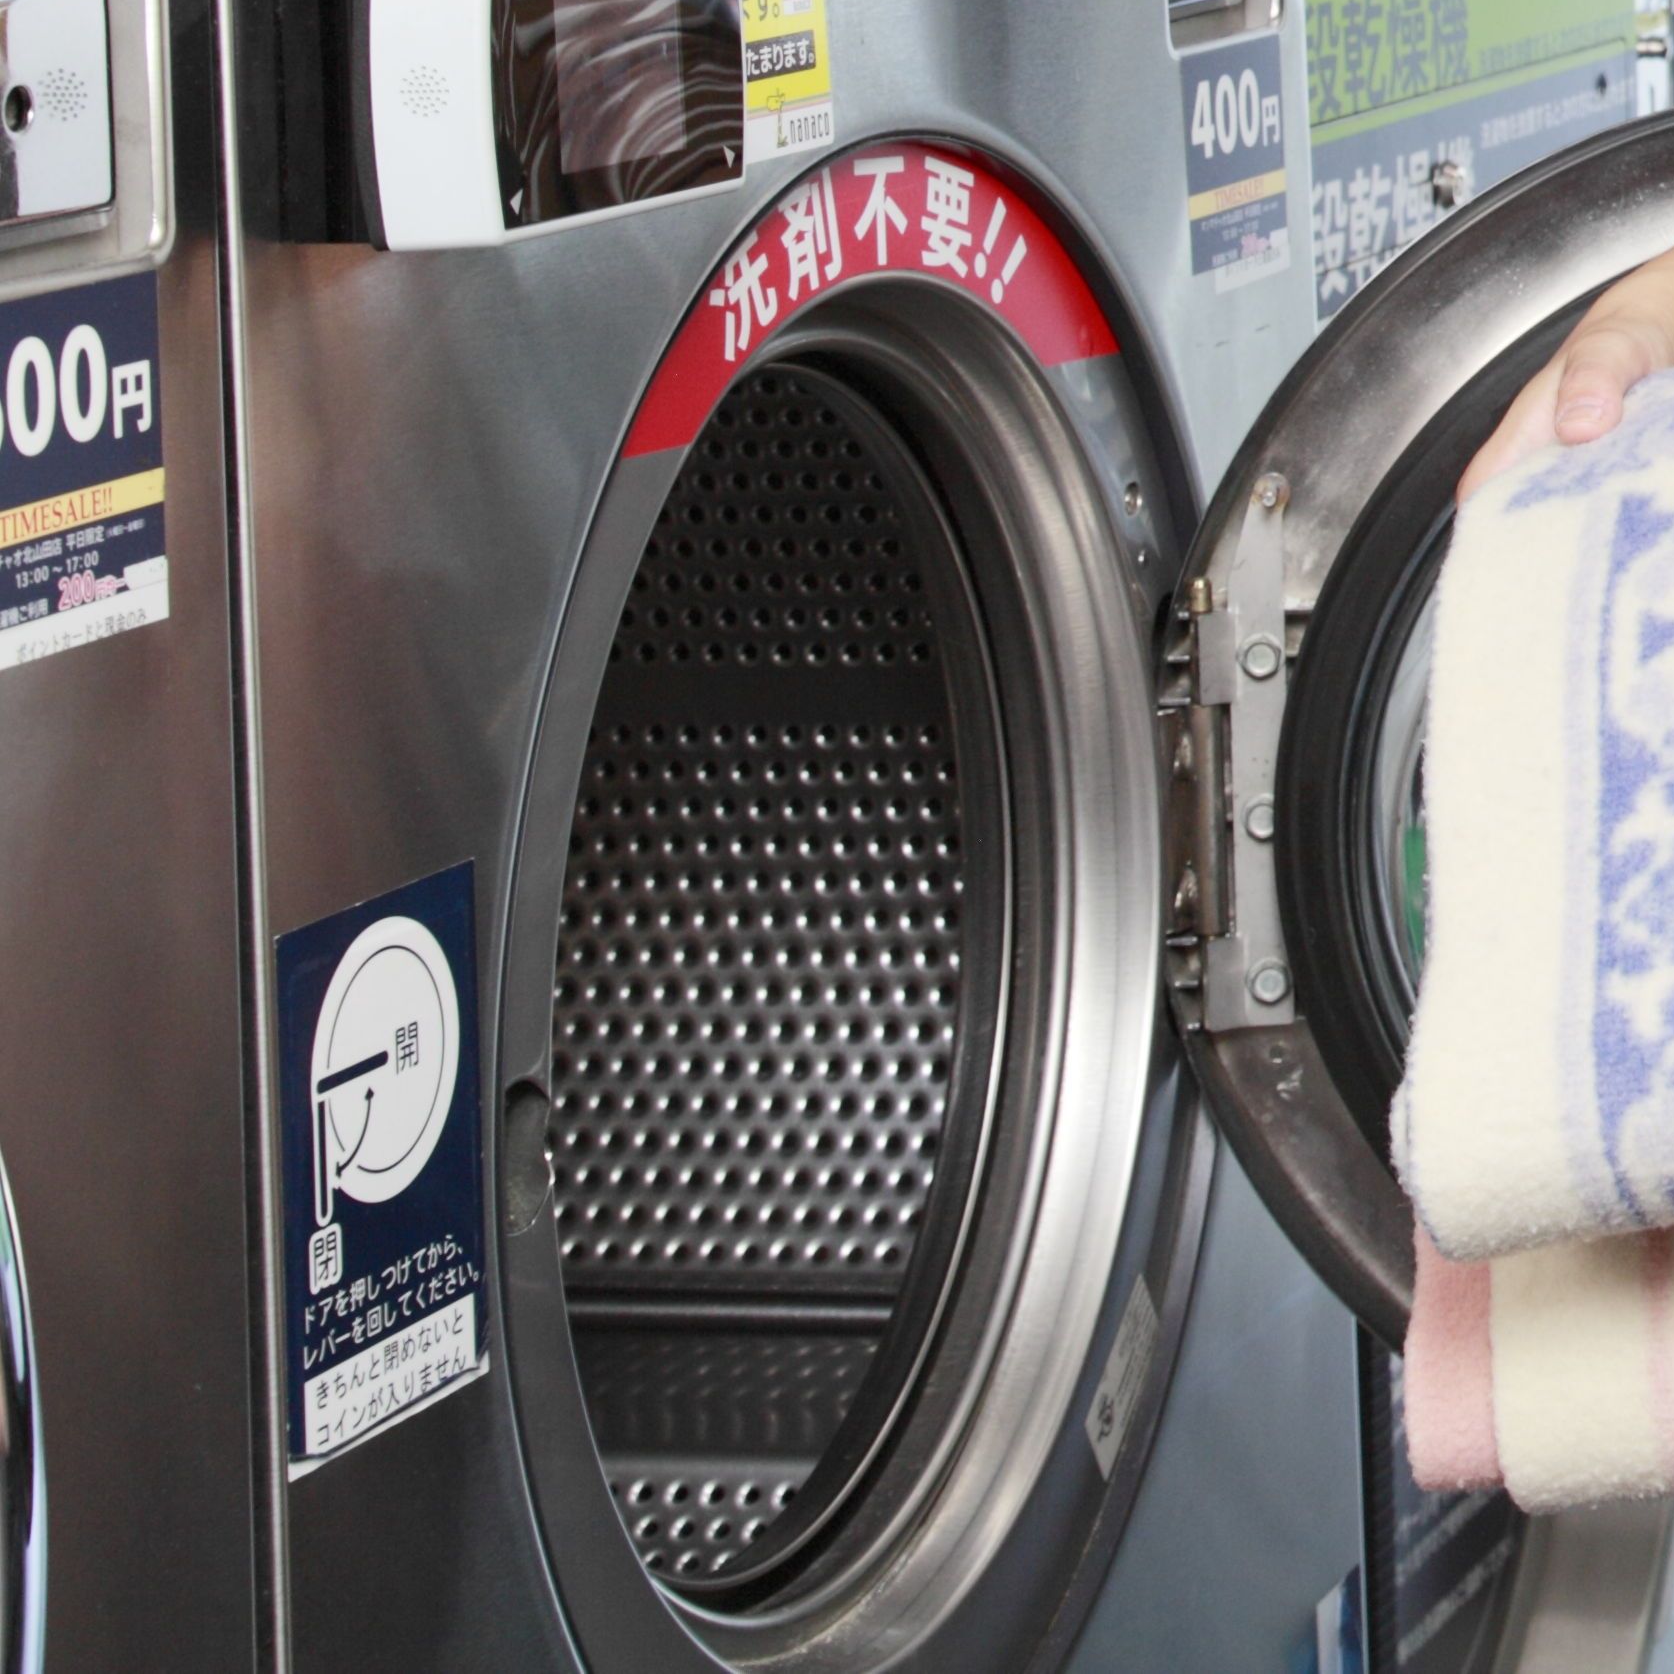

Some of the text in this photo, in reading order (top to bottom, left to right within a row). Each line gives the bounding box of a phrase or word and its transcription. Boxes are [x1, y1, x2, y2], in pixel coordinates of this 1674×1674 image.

[789, 111, 830, 144] nanaco
[1190, 67, 1281, 160] 400円
[0, 324, 153, 458] 00円
[15, 565, 50, 590] 13:00
[66, 549, 100, 574] 17:00
[395, 1020, 420, 1075] 開
[303, 1234, 465, 1335] ドアを押しつけてから、
[313, 1228, 339, 1282] 閉
[302, 1262, 481, 1371] レバーを回してください。
[315, 1308, 465, 1410] きちんと閉めないと
[316, 1342, 468, 1447] コインが入りません
